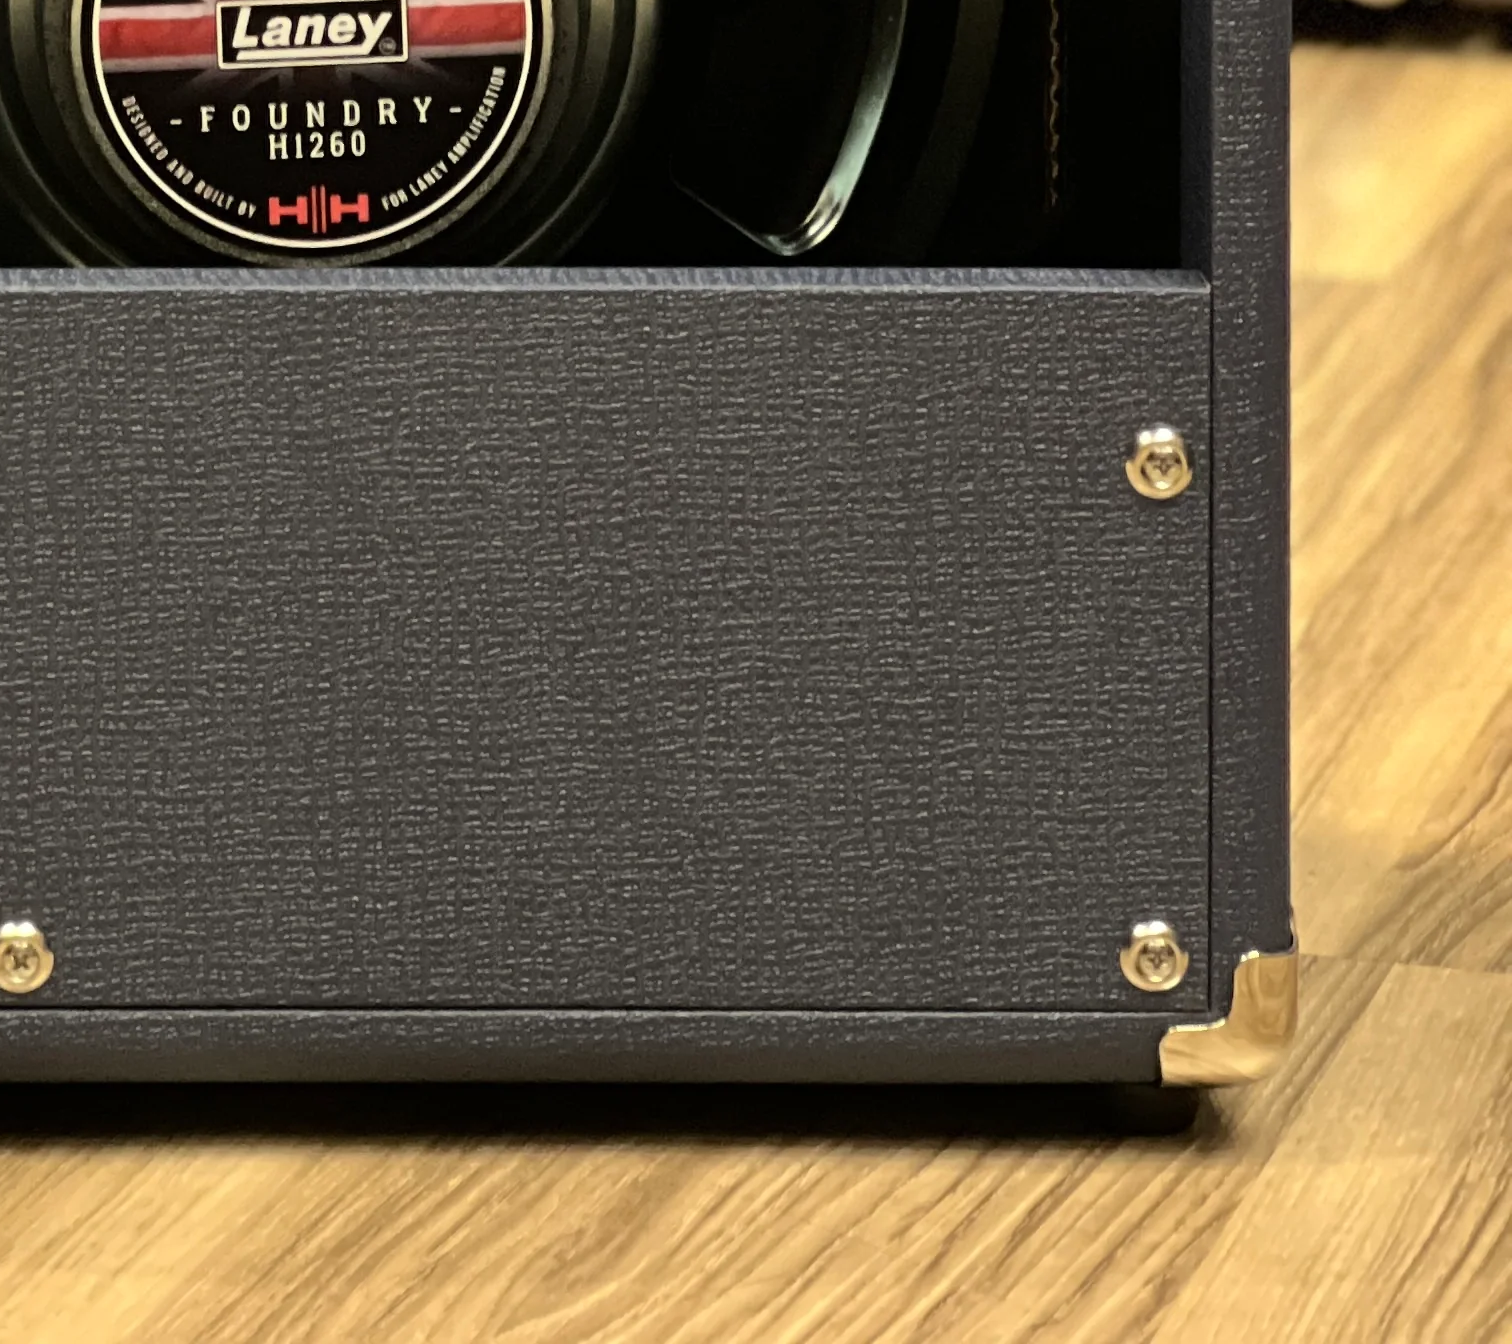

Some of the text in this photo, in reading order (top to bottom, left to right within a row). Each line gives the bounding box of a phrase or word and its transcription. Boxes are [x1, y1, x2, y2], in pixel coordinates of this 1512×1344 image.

[232, 6, 393, 62] Laney
[121, 95, 257, 219] DESIGNED AND BUILT BY
[199, 95, 435, 133] FOUNDRY
[381, 66, 507, 212] FOR LANEY AMPLIFICATION
